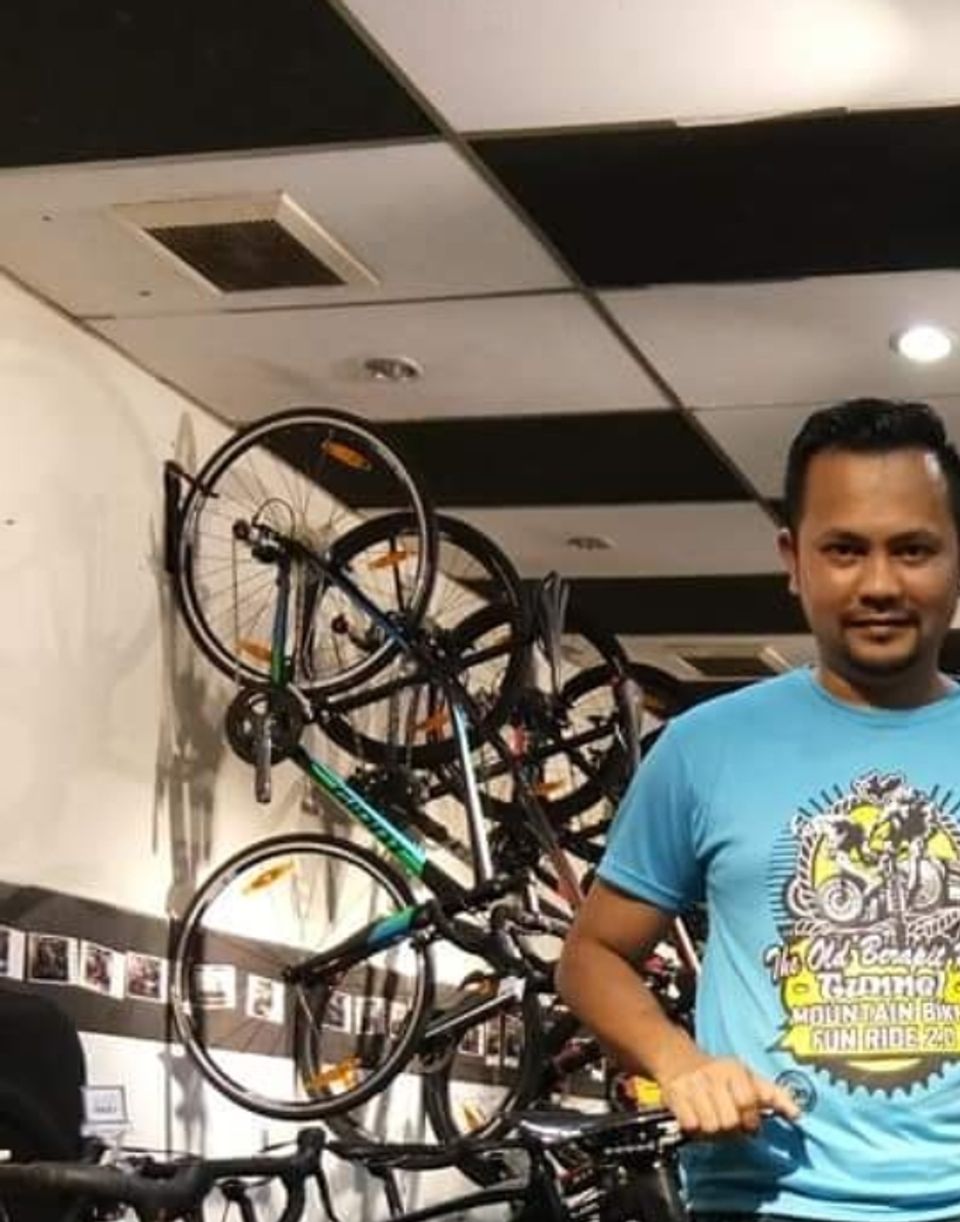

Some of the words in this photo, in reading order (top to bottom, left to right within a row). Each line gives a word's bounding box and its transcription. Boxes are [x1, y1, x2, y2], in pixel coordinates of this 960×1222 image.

[807, 936, 850, 971] Old
[791, 1001, 915, 1026] MOUNTAIN
[813, 1027, 858, 1050] FUN
[865, 1026, 919, 1049] RIDE
